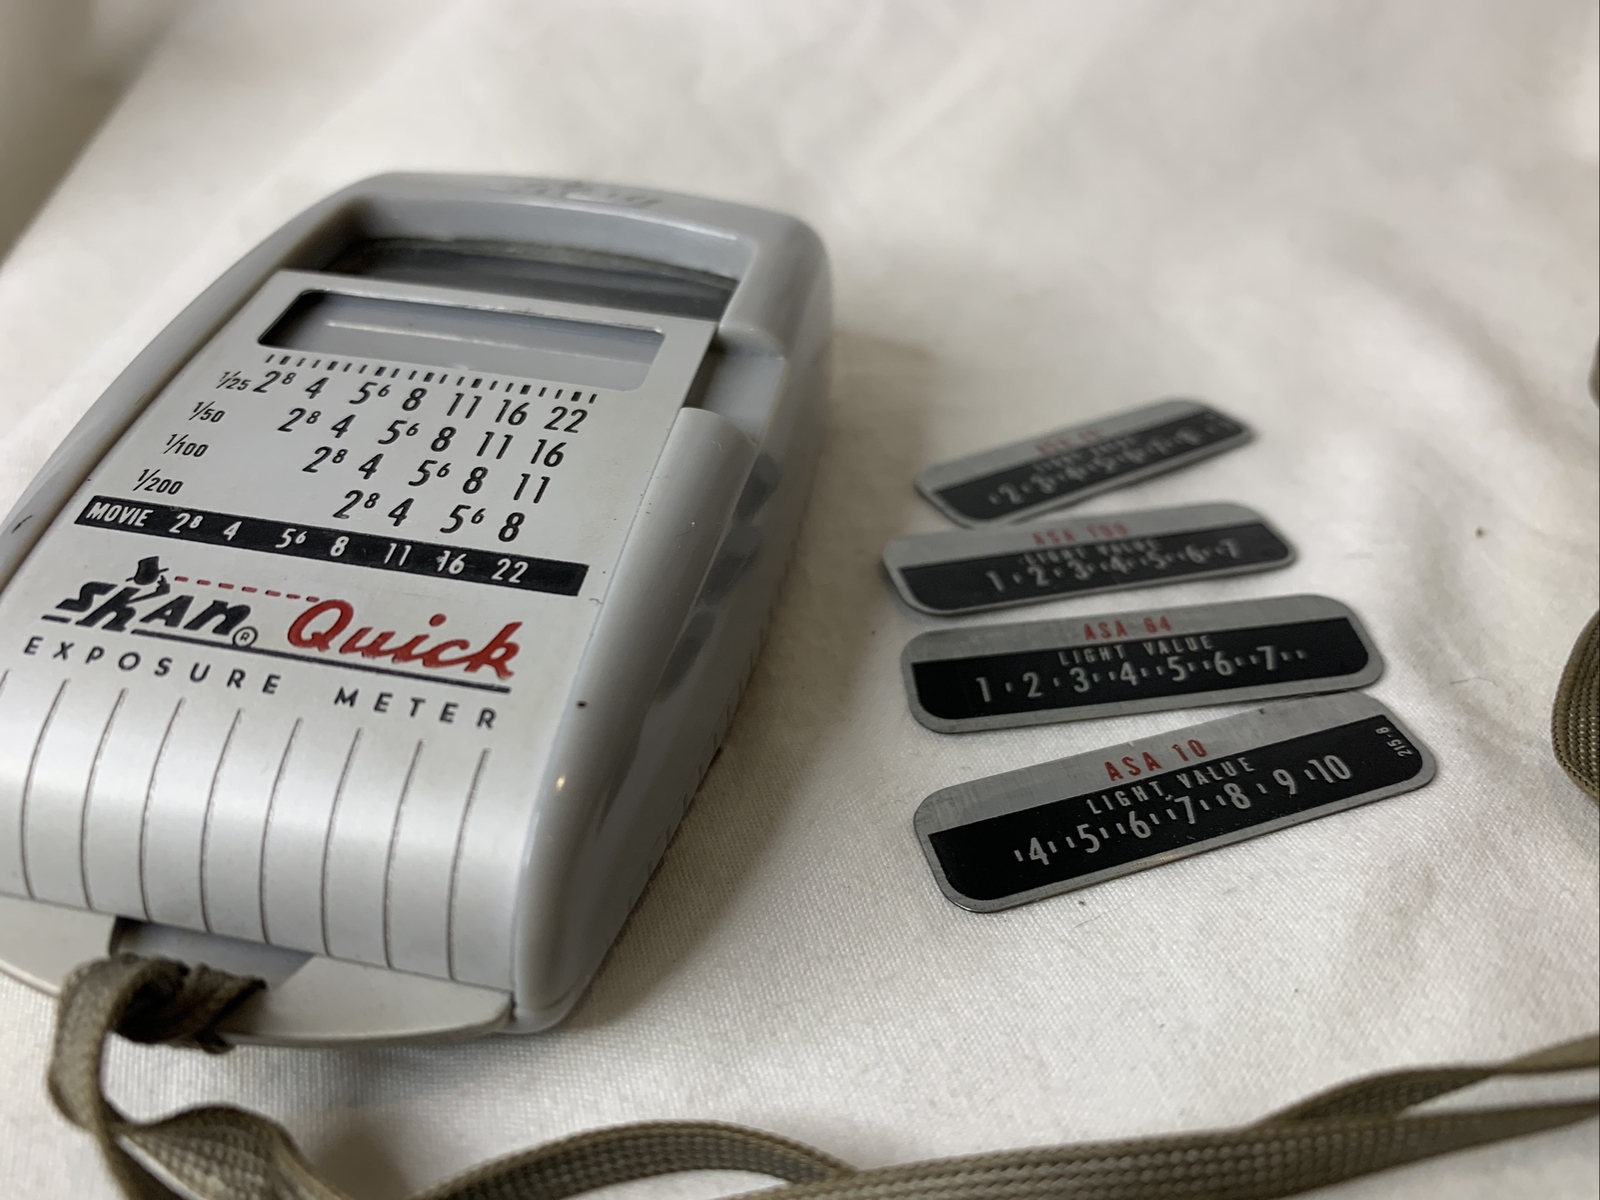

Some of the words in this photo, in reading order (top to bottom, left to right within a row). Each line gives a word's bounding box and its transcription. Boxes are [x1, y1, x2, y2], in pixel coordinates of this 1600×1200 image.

[189, 401, 226, 423] 1/50
[331, 414, 356, 439] 4
[430, 426, 457, 452] 8
[476, 431, 514, 460] 11
[530, 439, 567, 467] 16
[305, 377, 329, 399] 4
[402, 388, 428, 411] 8
[447, 393, 483, 419] 11
[495, 399, 530, 426] 16
[543, 406, 588, 433] 22
[163, 433, 209, 457] 1/100
[358, 453, 384, 480] 4
[462, 466, 489, 494] 8
[513, 473, 551, 504] 11
[133, 468, 184, 495] 1/200
[388, 497, 415, 527] 4
[498, 512, 526, 542] 8
[86, 501, 154, 528] MOVIE
[222, 520, 243, 541] 4
[330, 536, 349, 557] 8
[383, 542, 412, 567] 11
[437, 550, 467, 575] 16
[491, 558, 529, 584] 22
[1028, 563, 1051, 587] 2
[1067, 558, 1091, 581] 3
[1110, 554, 1129, 575] 4
[1147, 550, 1168, 570] 5
[1184, 543, 1206, 565] 6
[1219, 537, 1240, 559] 7
[286, 599, 523, 681] Quick
[1058, 645, 1126, 667] LIGHT
[1142, 635, 1215, 656] VALUE
[1083, 620, 1129, 640] ASA
[1143, 616, 1172, 634] 64
[24, 635, 283, 695] EXPOSURE
[332, 685, 499, 731] METER
[976, 677, 990, 702] 1
[1022, 671, 1043, 698] 2
[1069, 667, 1091, 693] 3
[1119, 661, 1139, 686] 4
[1166, 656, 1189, 682] 5
[1213, 650, 1234, 676] 6
[1256, 645, 1277, 671] 7
[1085, 780, 1167, 815] LIGHT
[1177, 756, 1255, 790] VALUE
[1104, 750, 1162, 782] ASA
[1171, 739, 1209, 762] 10
[1028, 837, 1050, 865] 4
[1076, 823, 1100, 853] 5
[1129, 811, 1151, 839] 6
[1174, 796, 1197, 825] 7
[1223, 782, 1251, 810] 8
[1272, 768, 1297, 795] 9
[1308, 754, 1352, 785] 10
